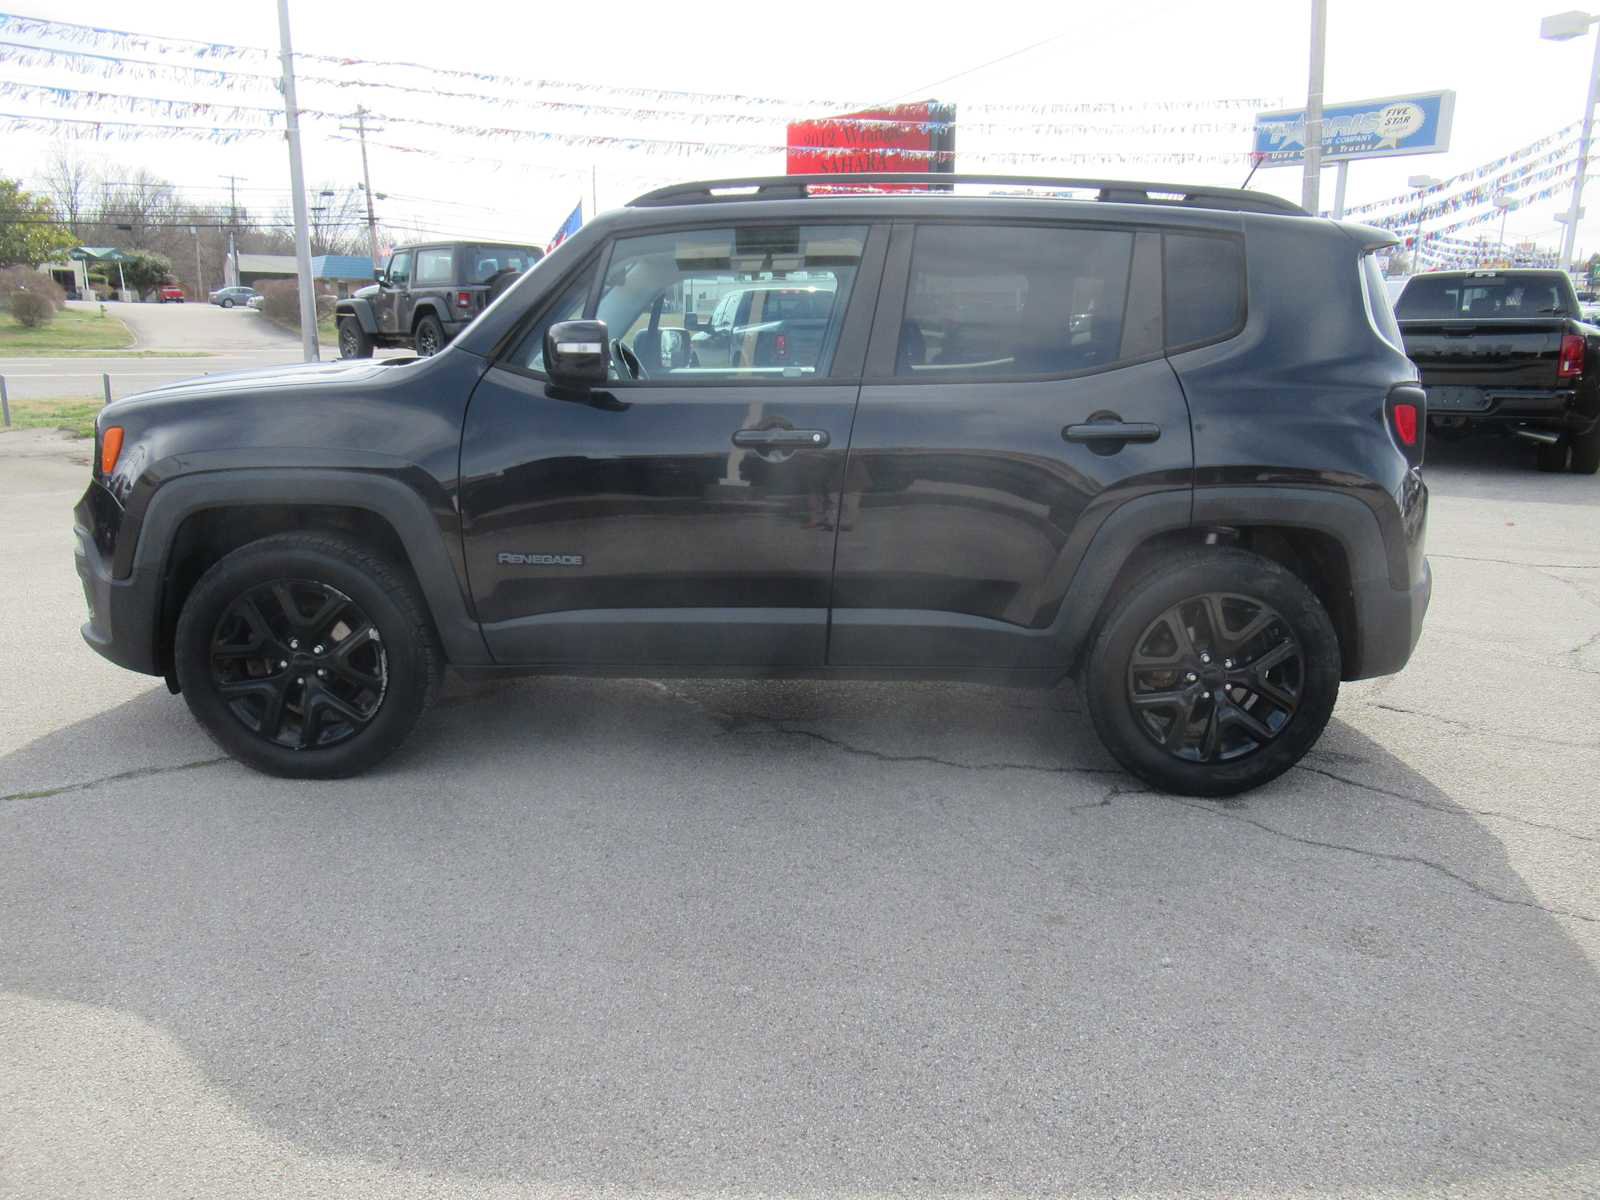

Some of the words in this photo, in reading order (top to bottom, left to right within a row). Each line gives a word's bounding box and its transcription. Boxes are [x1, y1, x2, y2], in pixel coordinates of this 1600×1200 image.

[1386, 106, 1411, 117] FIVE
[1384, 115, 1412, 127] STAR
[1335, 134, 1372, 145] COMPANY
[497, 552, 583, 566] RENEGADE
